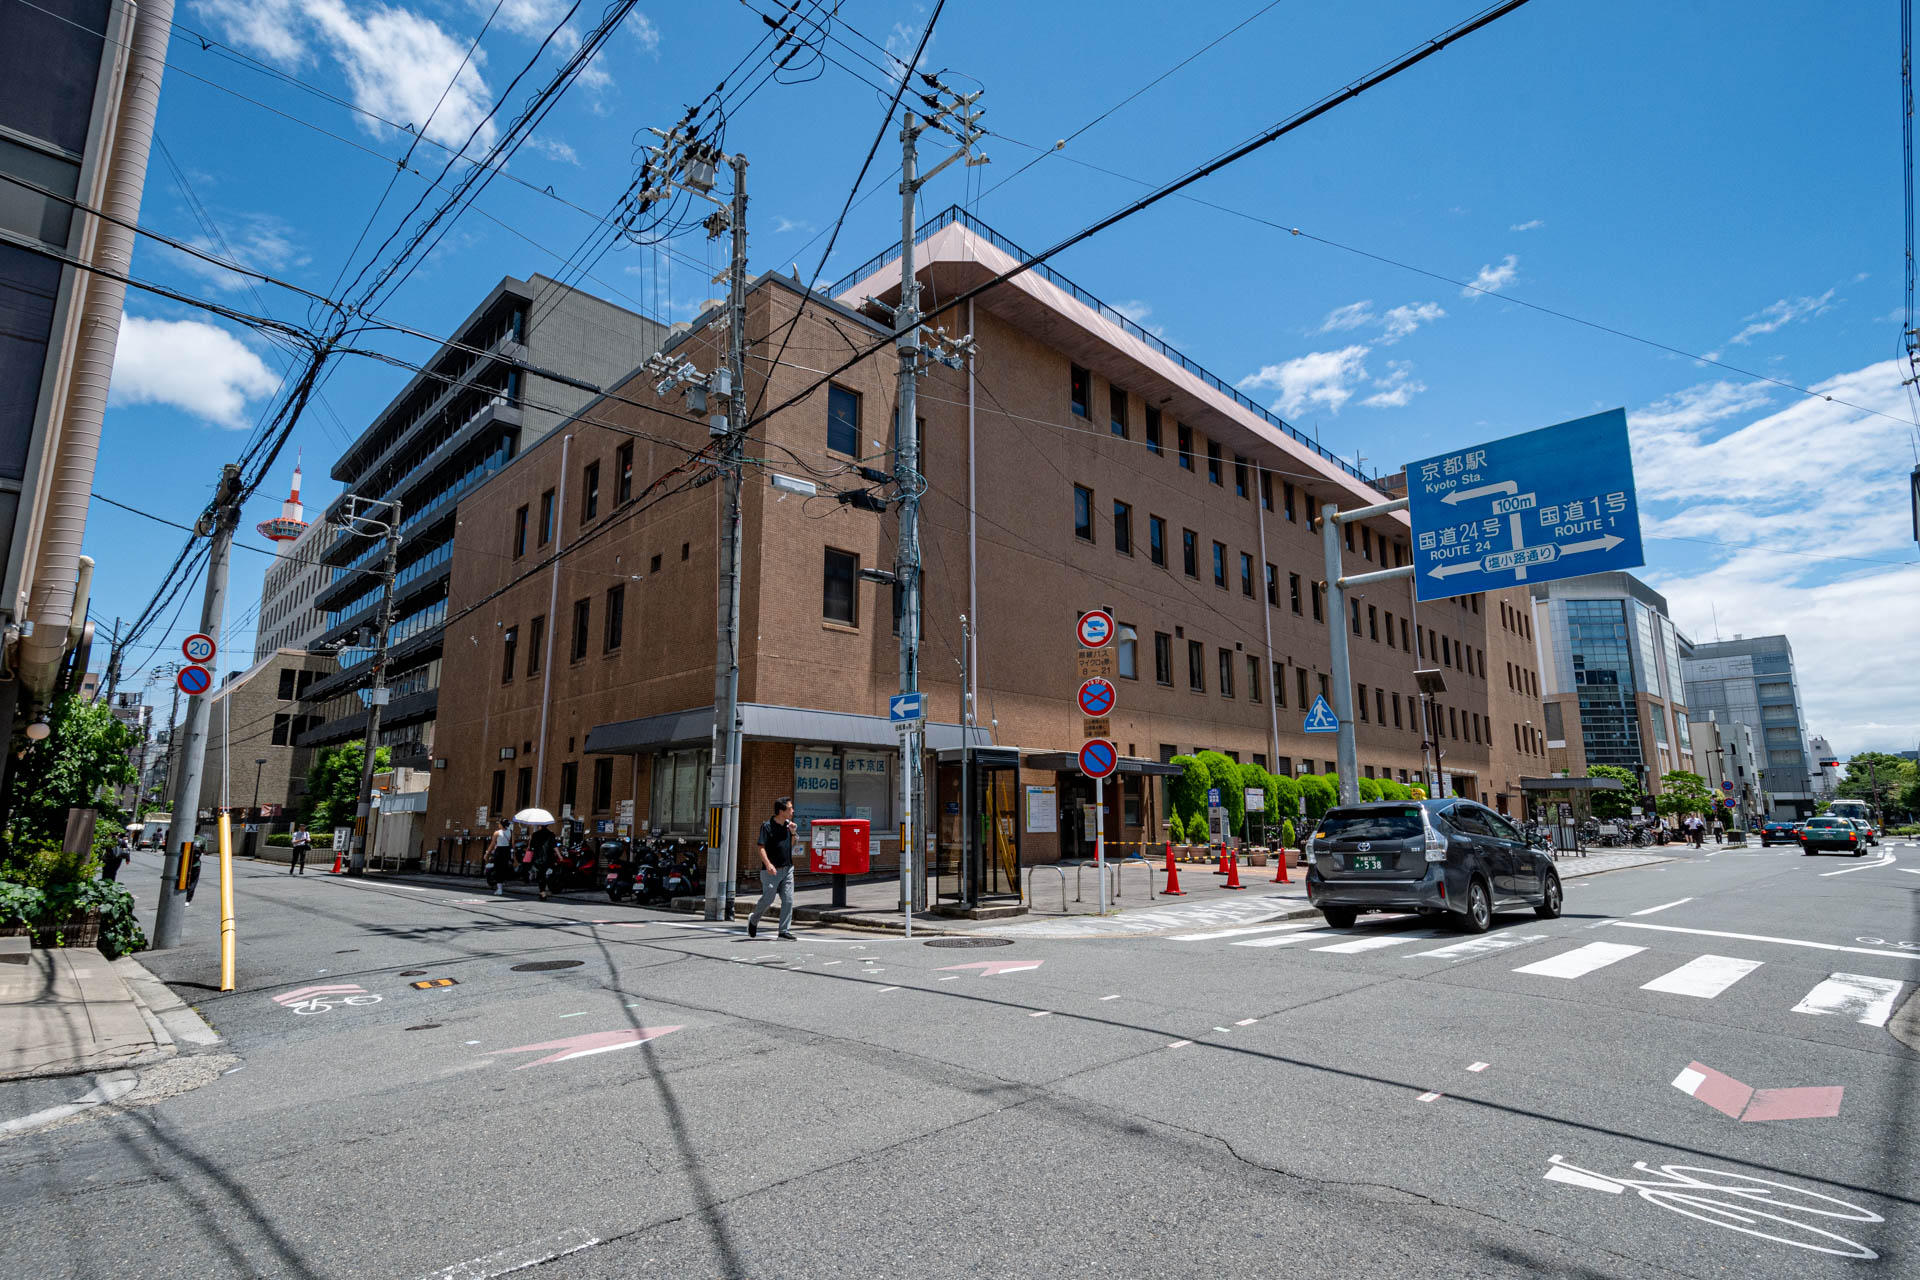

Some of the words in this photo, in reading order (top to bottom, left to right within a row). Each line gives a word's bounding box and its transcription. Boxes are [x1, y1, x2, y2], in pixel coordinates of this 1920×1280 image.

[1421, 450, 1487, 482] 京都駅
[1425, 479, 1457, 493] Kyoto
[1462, 473, 1484, 485] Sta.
[1498, 496, 1532, 511] 100m
[1540, 492, 1627, 526] 国道1号
[1419, 518, 1501, 550] 国道24号
[1555, 520, 1602, 537] ROUTE
[1608, 516, 1616, 528] 1
[1430, 545, 1470, 560] ROUTE
[1476, 540, 1491, 552] 24
[1488, 549, 1551, 569] 塩小路通り
[190, 641, 210, 656] 20
[797, 777, 839, 790] 防犯の日
[1372, 861, 1382, 869] 38
